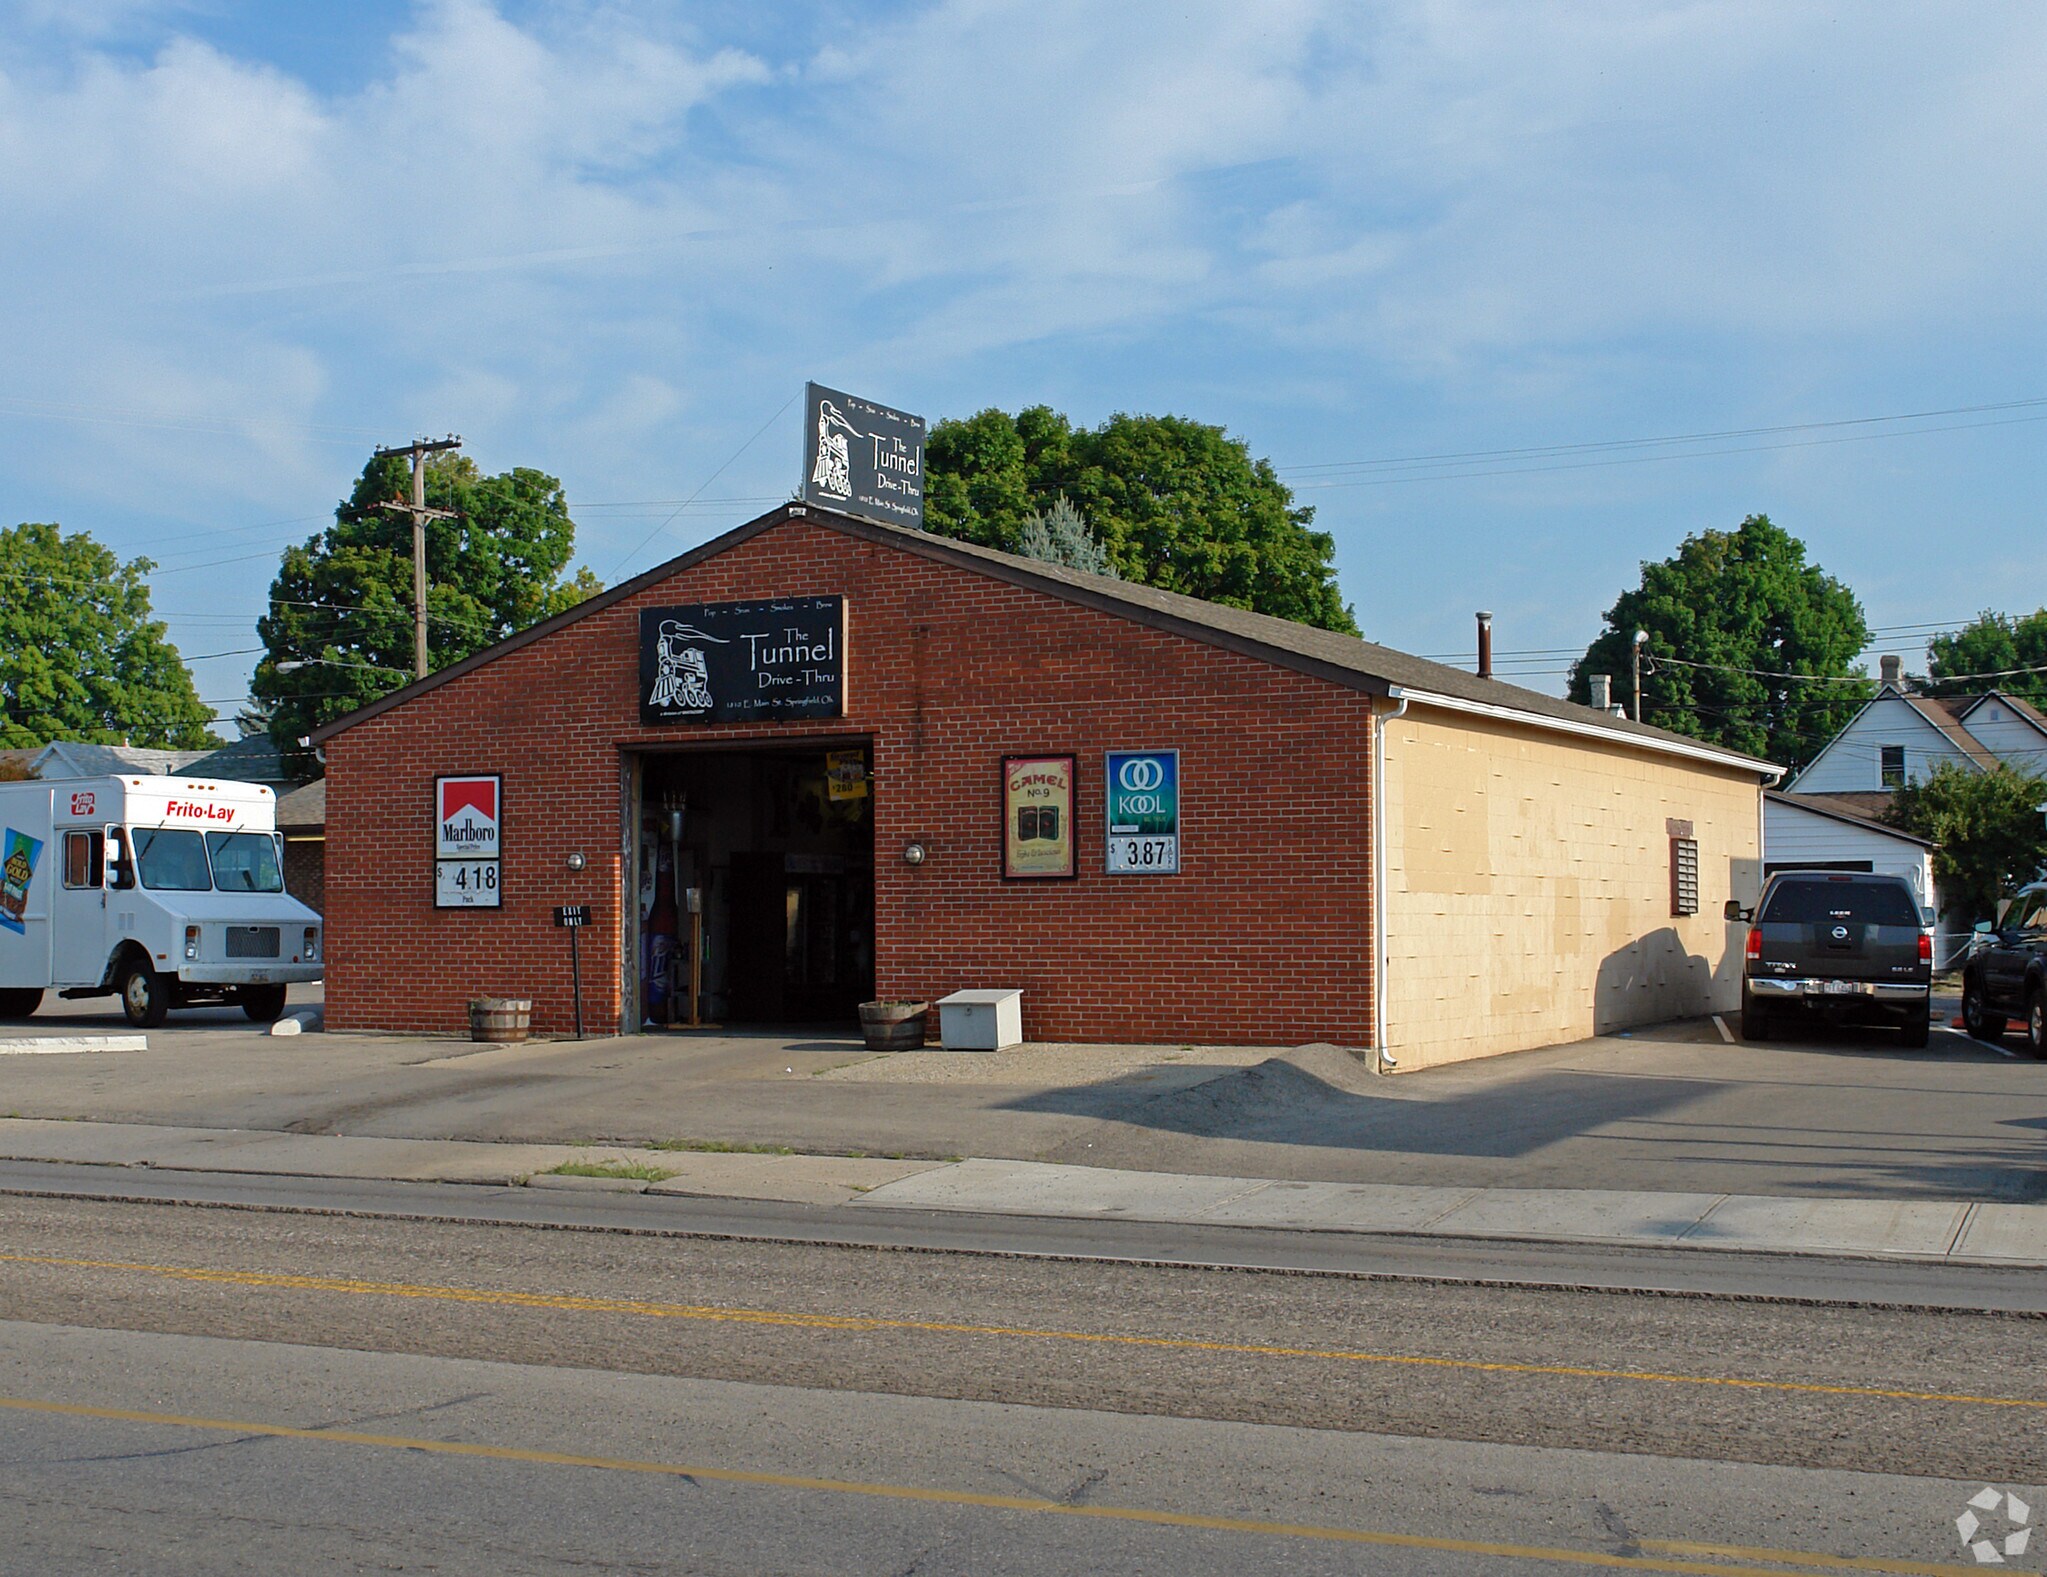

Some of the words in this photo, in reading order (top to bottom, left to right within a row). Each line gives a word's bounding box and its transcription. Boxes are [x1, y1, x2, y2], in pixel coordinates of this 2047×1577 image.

[868, 432, 920, 476] Tunnel
[892, 436, 908, 453] The
[877, 473, 920, 497] Drive-Thru
[783, 628, 809, 644] The
[739, 627, 834, 671] Tunnel
[758, 669, 835, 688] Drive-Thru
[1009, 773, 1067, 792] CAMEL
[1043, 788, 1050, 798] 9
[1118, 795, 1166, 815] KOOL
[442, 818, 495, 842] Marlboro
[1110, 843, 1116, 854] $
[1127, 841, 1166, 865] 3.87
[5, 864, 29, 881] GOLD
[437, 867, 443, 878] $
[456, 866, 496, 890] 4.18
[462, 895, 474, 903] Pack
[562, 907, 582, 916] EXIT
[563, 917, 582, 926] ONLY
